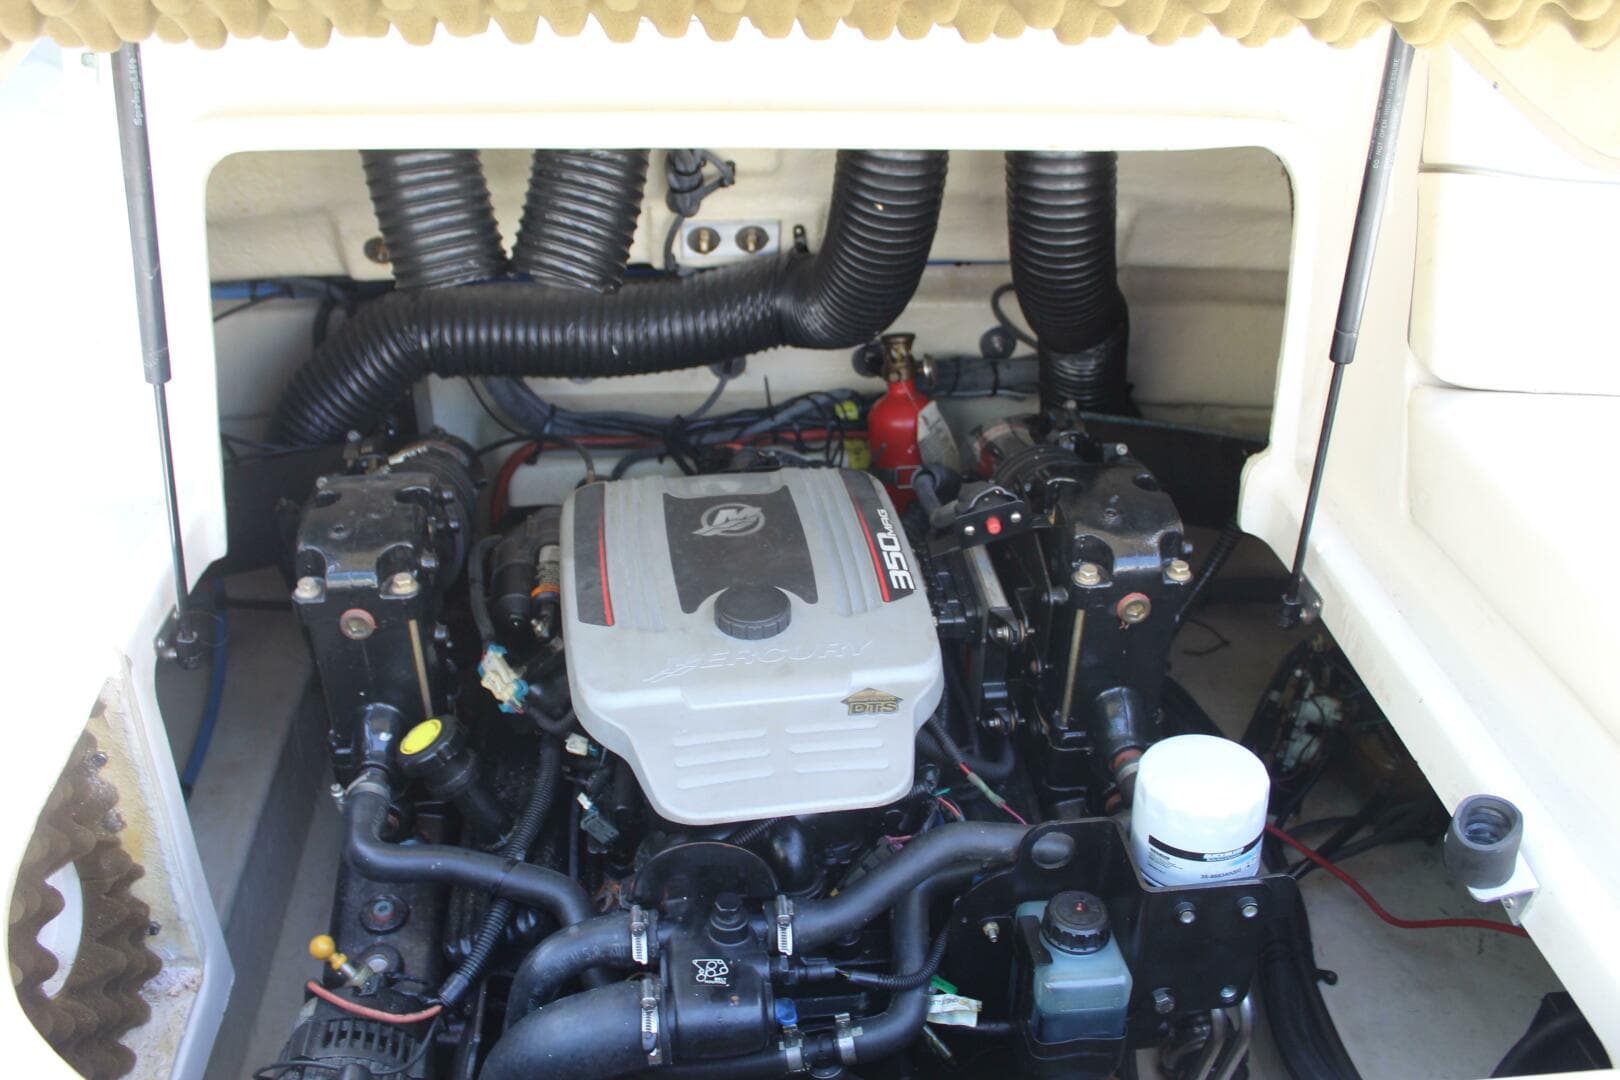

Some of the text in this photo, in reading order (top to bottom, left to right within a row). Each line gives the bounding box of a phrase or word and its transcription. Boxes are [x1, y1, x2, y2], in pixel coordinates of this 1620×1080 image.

[1380, 118, 1388, 138] OPEN
[1376, 141, 1385, 156] NOT
[1372, 158, 1380, 169] DO
[877, 508, 916, 590] 350 MAG
[642, 640, 873, 683] MERCURY
[849, 701, 898, 715] DTS
